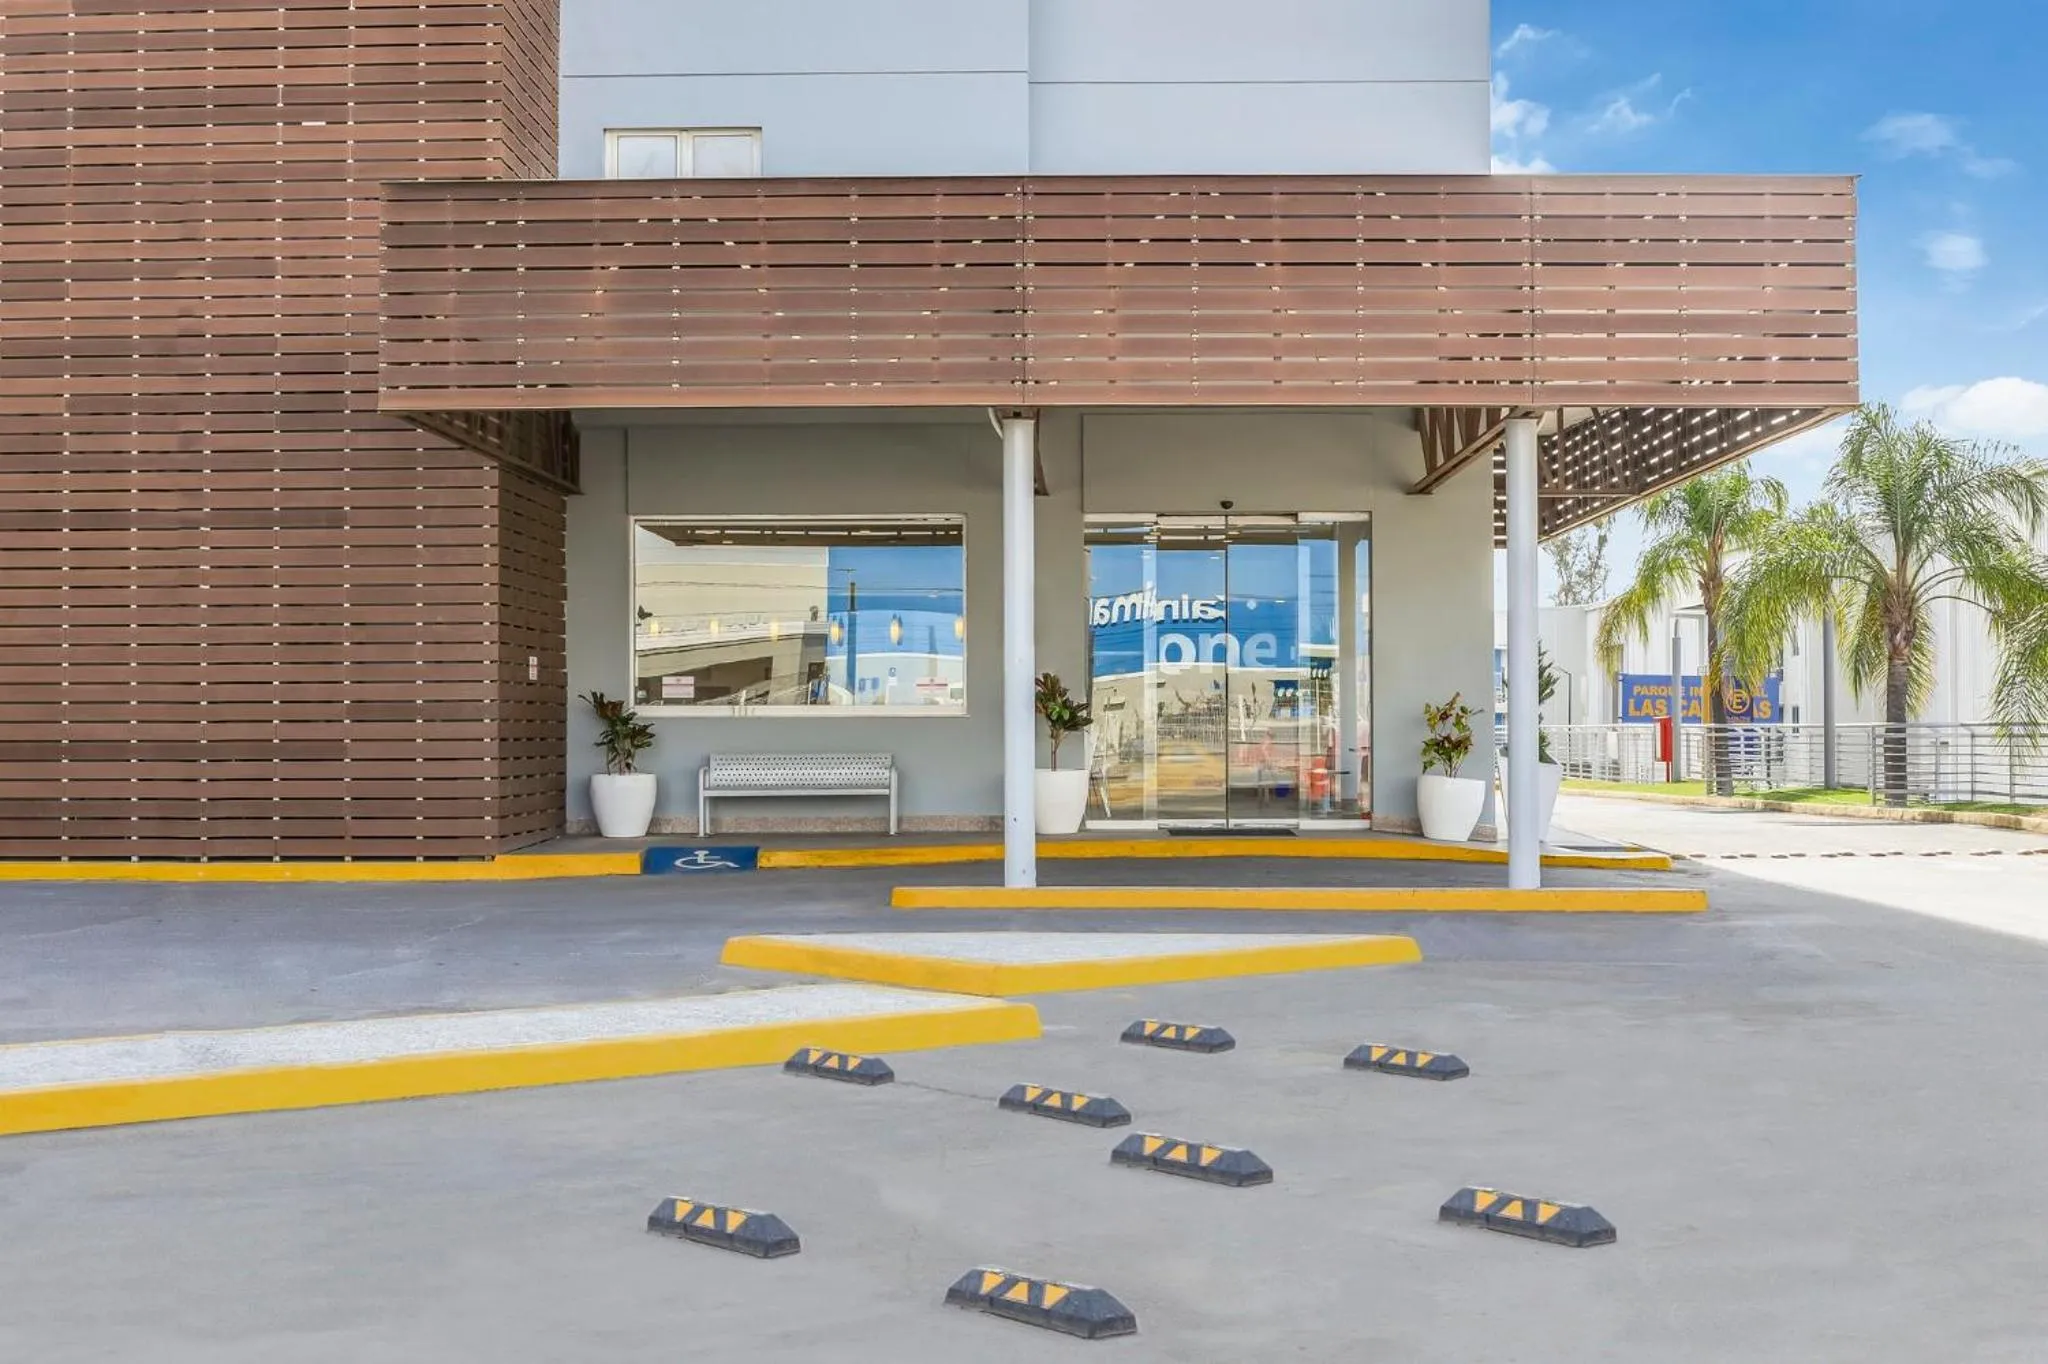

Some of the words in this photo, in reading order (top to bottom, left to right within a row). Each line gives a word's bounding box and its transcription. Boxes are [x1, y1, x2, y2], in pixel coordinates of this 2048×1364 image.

[1159, 632, 1277, 675] one
[1634, 686, 1684, 696] PARQE
[1629, 699, 1667, 717] LAS
